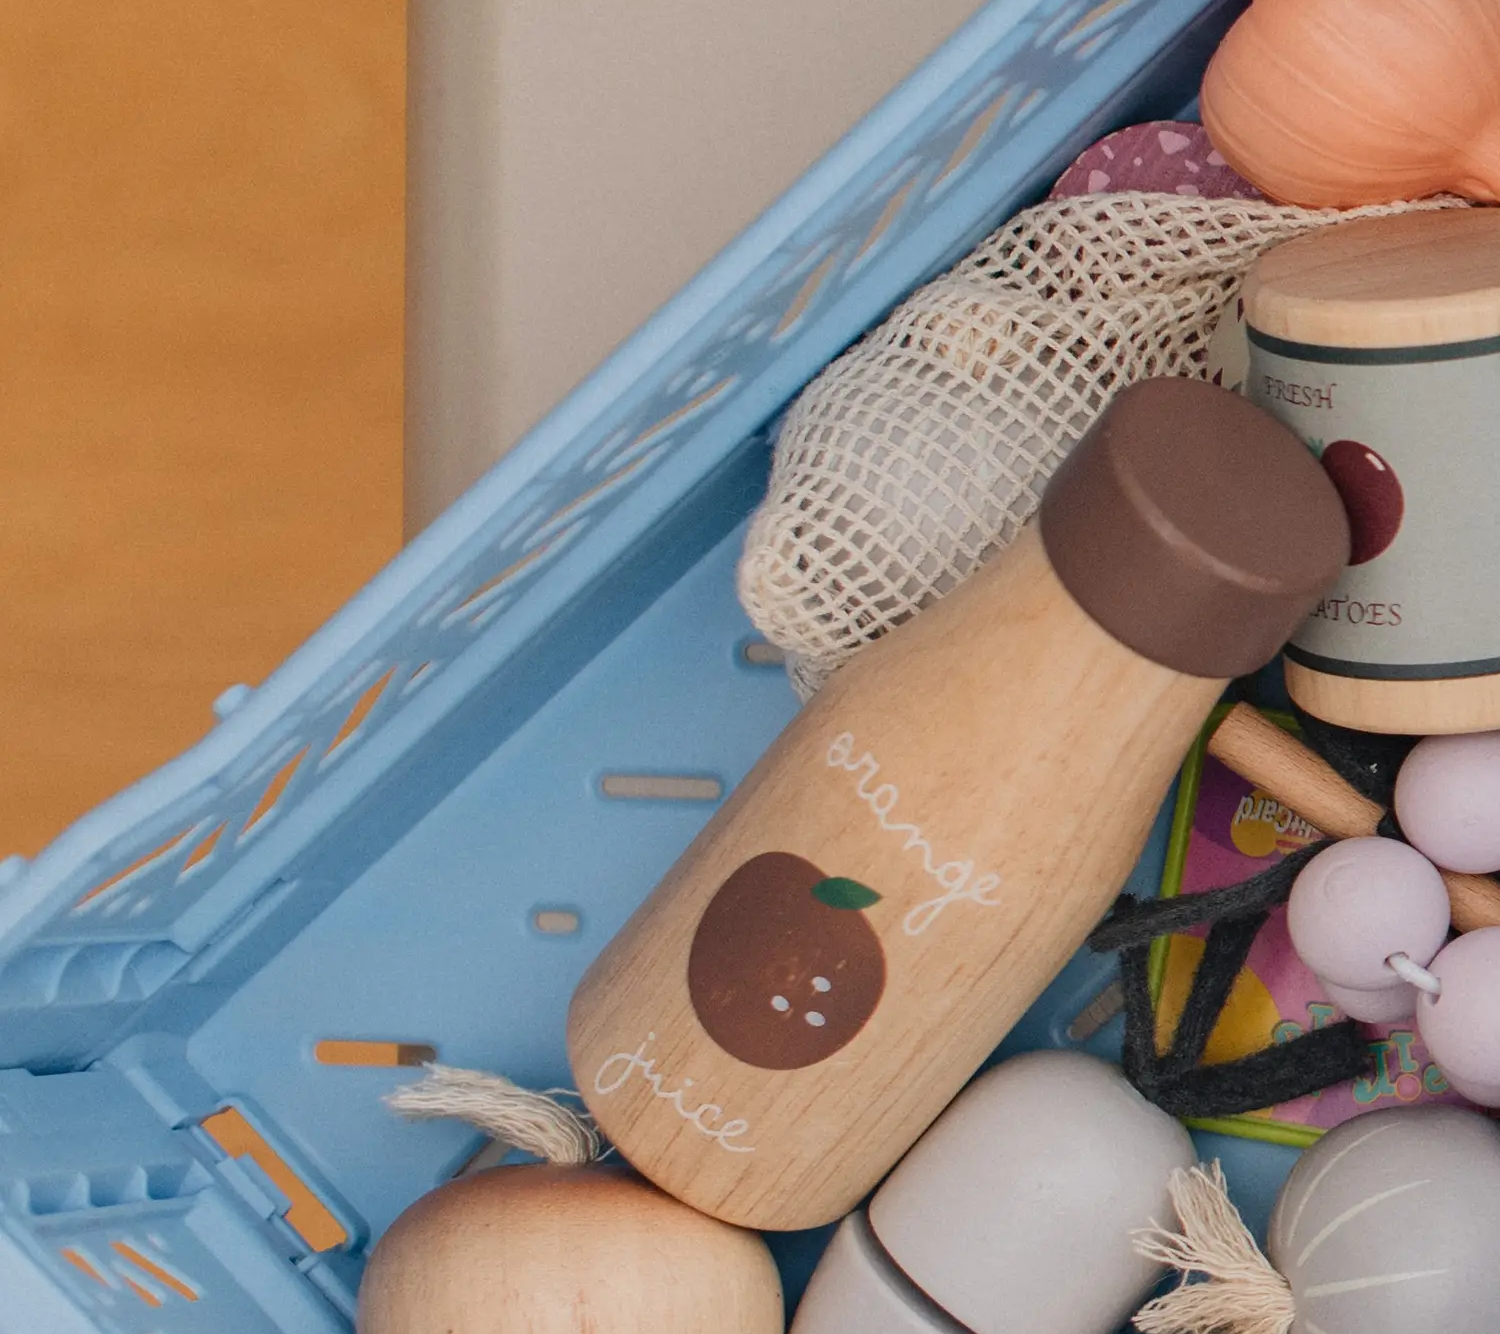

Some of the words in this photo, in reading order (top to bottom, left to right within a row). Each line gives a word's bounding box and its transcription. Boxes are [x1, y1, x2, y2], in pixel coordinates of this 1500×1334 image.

[1263, 374, 1338, 410] FRESH
[1309, 594, 1403, 627] ATOES
[826, 730, 1004, 937] orange
[594, 1031, 757, 1154] juice
